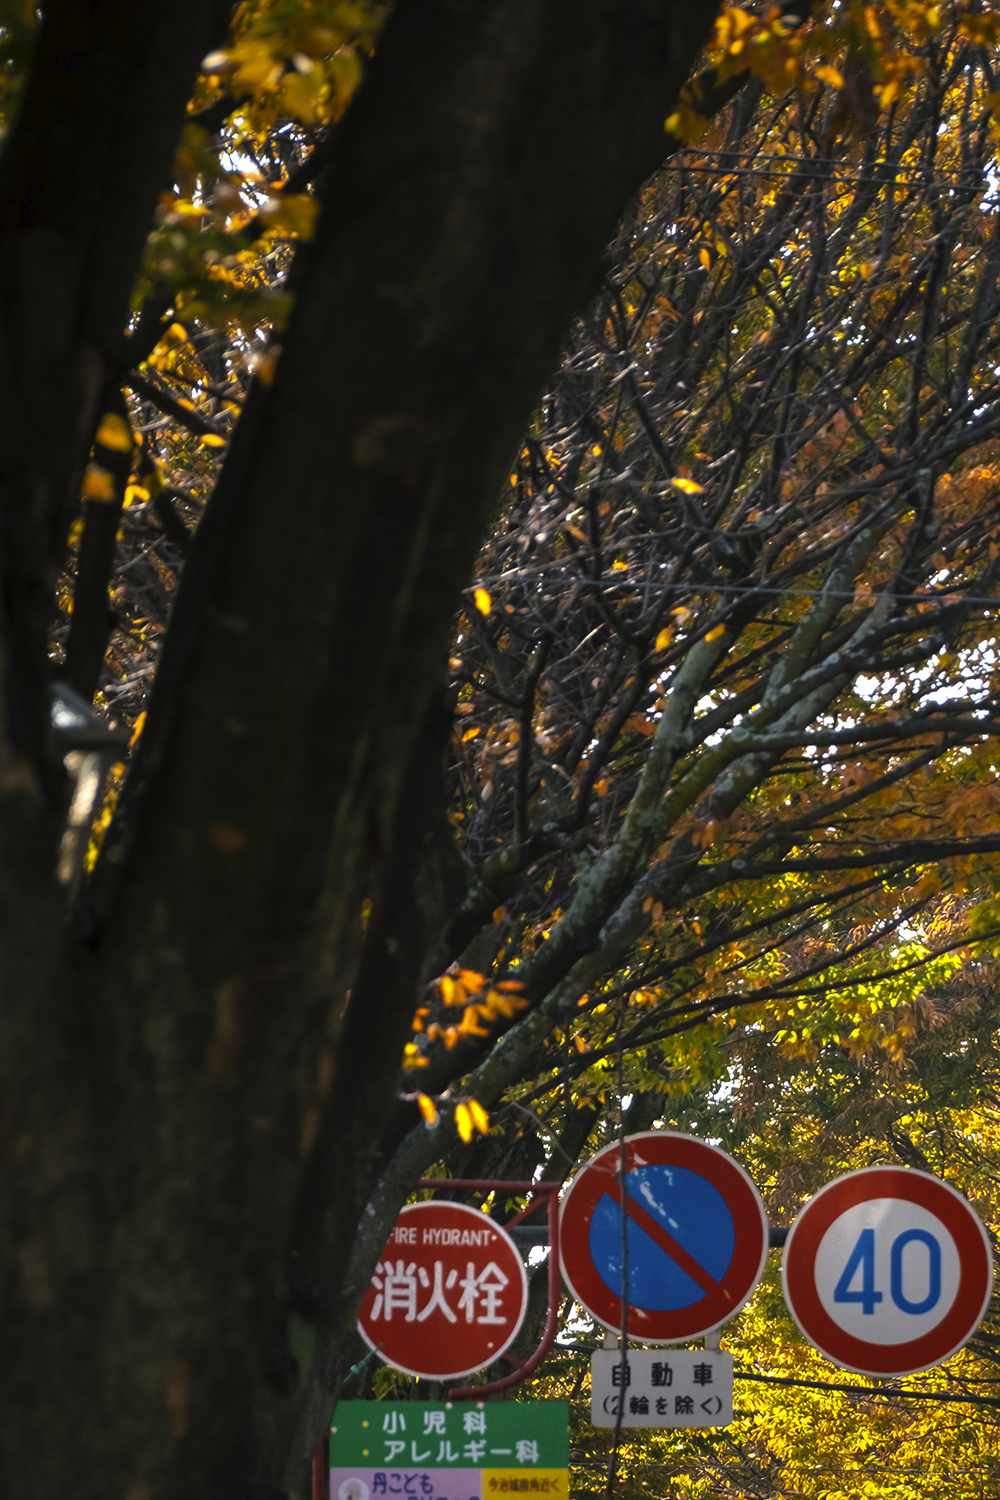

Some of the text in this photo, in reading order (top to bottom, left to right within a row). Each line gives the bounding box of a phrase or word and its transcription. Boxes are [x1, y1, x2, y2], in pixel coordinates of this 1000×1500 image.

[422, 1228, 491, 1246] HYDRANT
[834, 1228, 942, 1315] 40
[370, 1259, 509, 1325] 消火栓
[611, 1362, 714, 1387] 自動車
[382, 1410, 487, 1436] 小児科
[383, 1439, 539, 1464] アレルギー科
[372, 1472, 434, 1495] 丹こども
